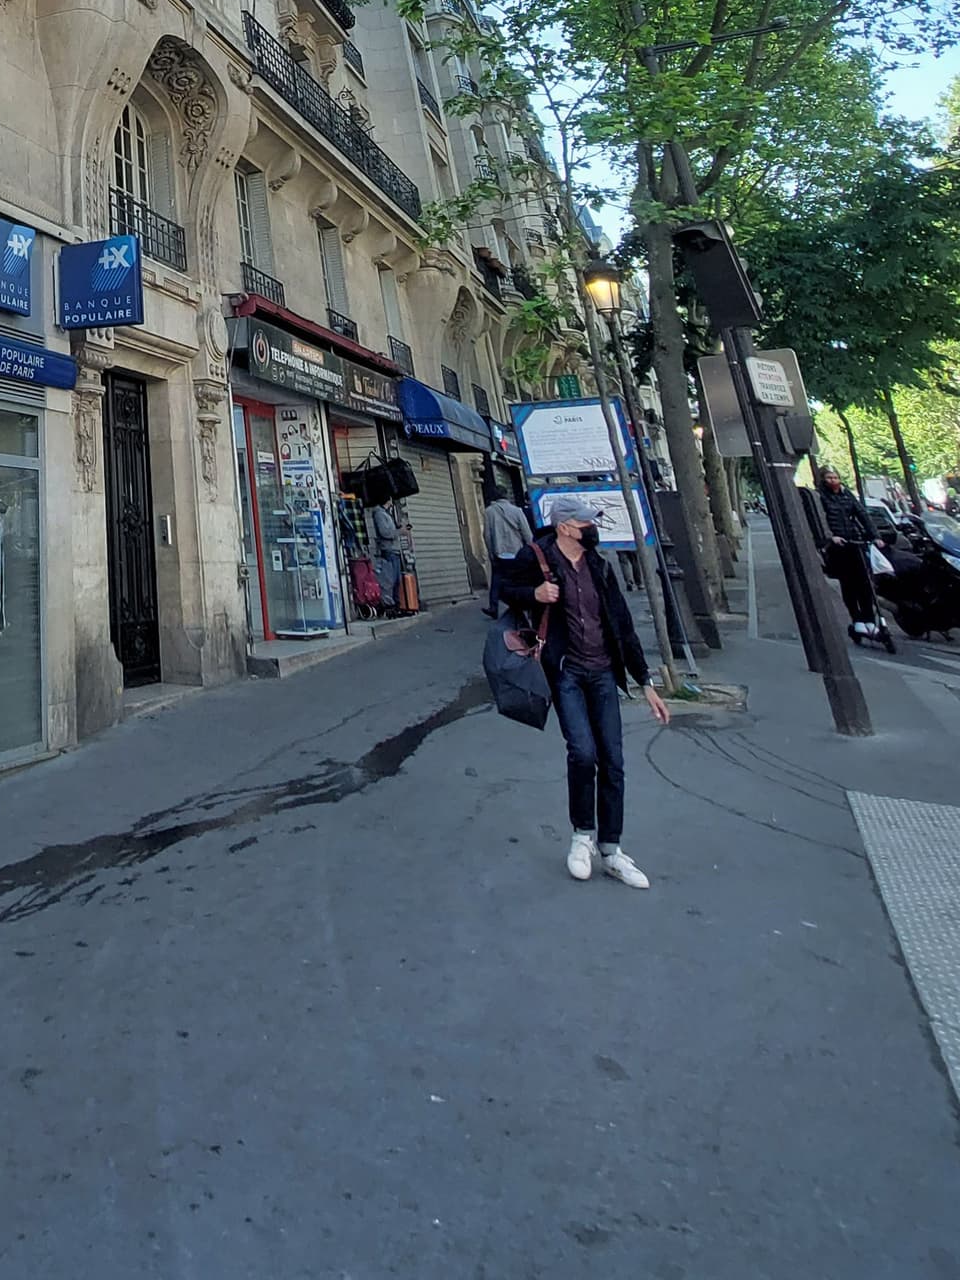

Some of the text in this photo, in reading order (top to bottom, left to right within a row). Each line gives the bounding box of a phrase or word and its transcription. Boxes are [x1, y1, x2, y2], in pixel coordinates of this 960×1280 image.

[64, 295, 132, 311] BANQUE
[64, 308, 133, 324] POPULAIRE
[1, 347, 45, 369] POPULAIRE
[0, 361, 11, 374] DE
[11, 365, 35, 380] PARIS
